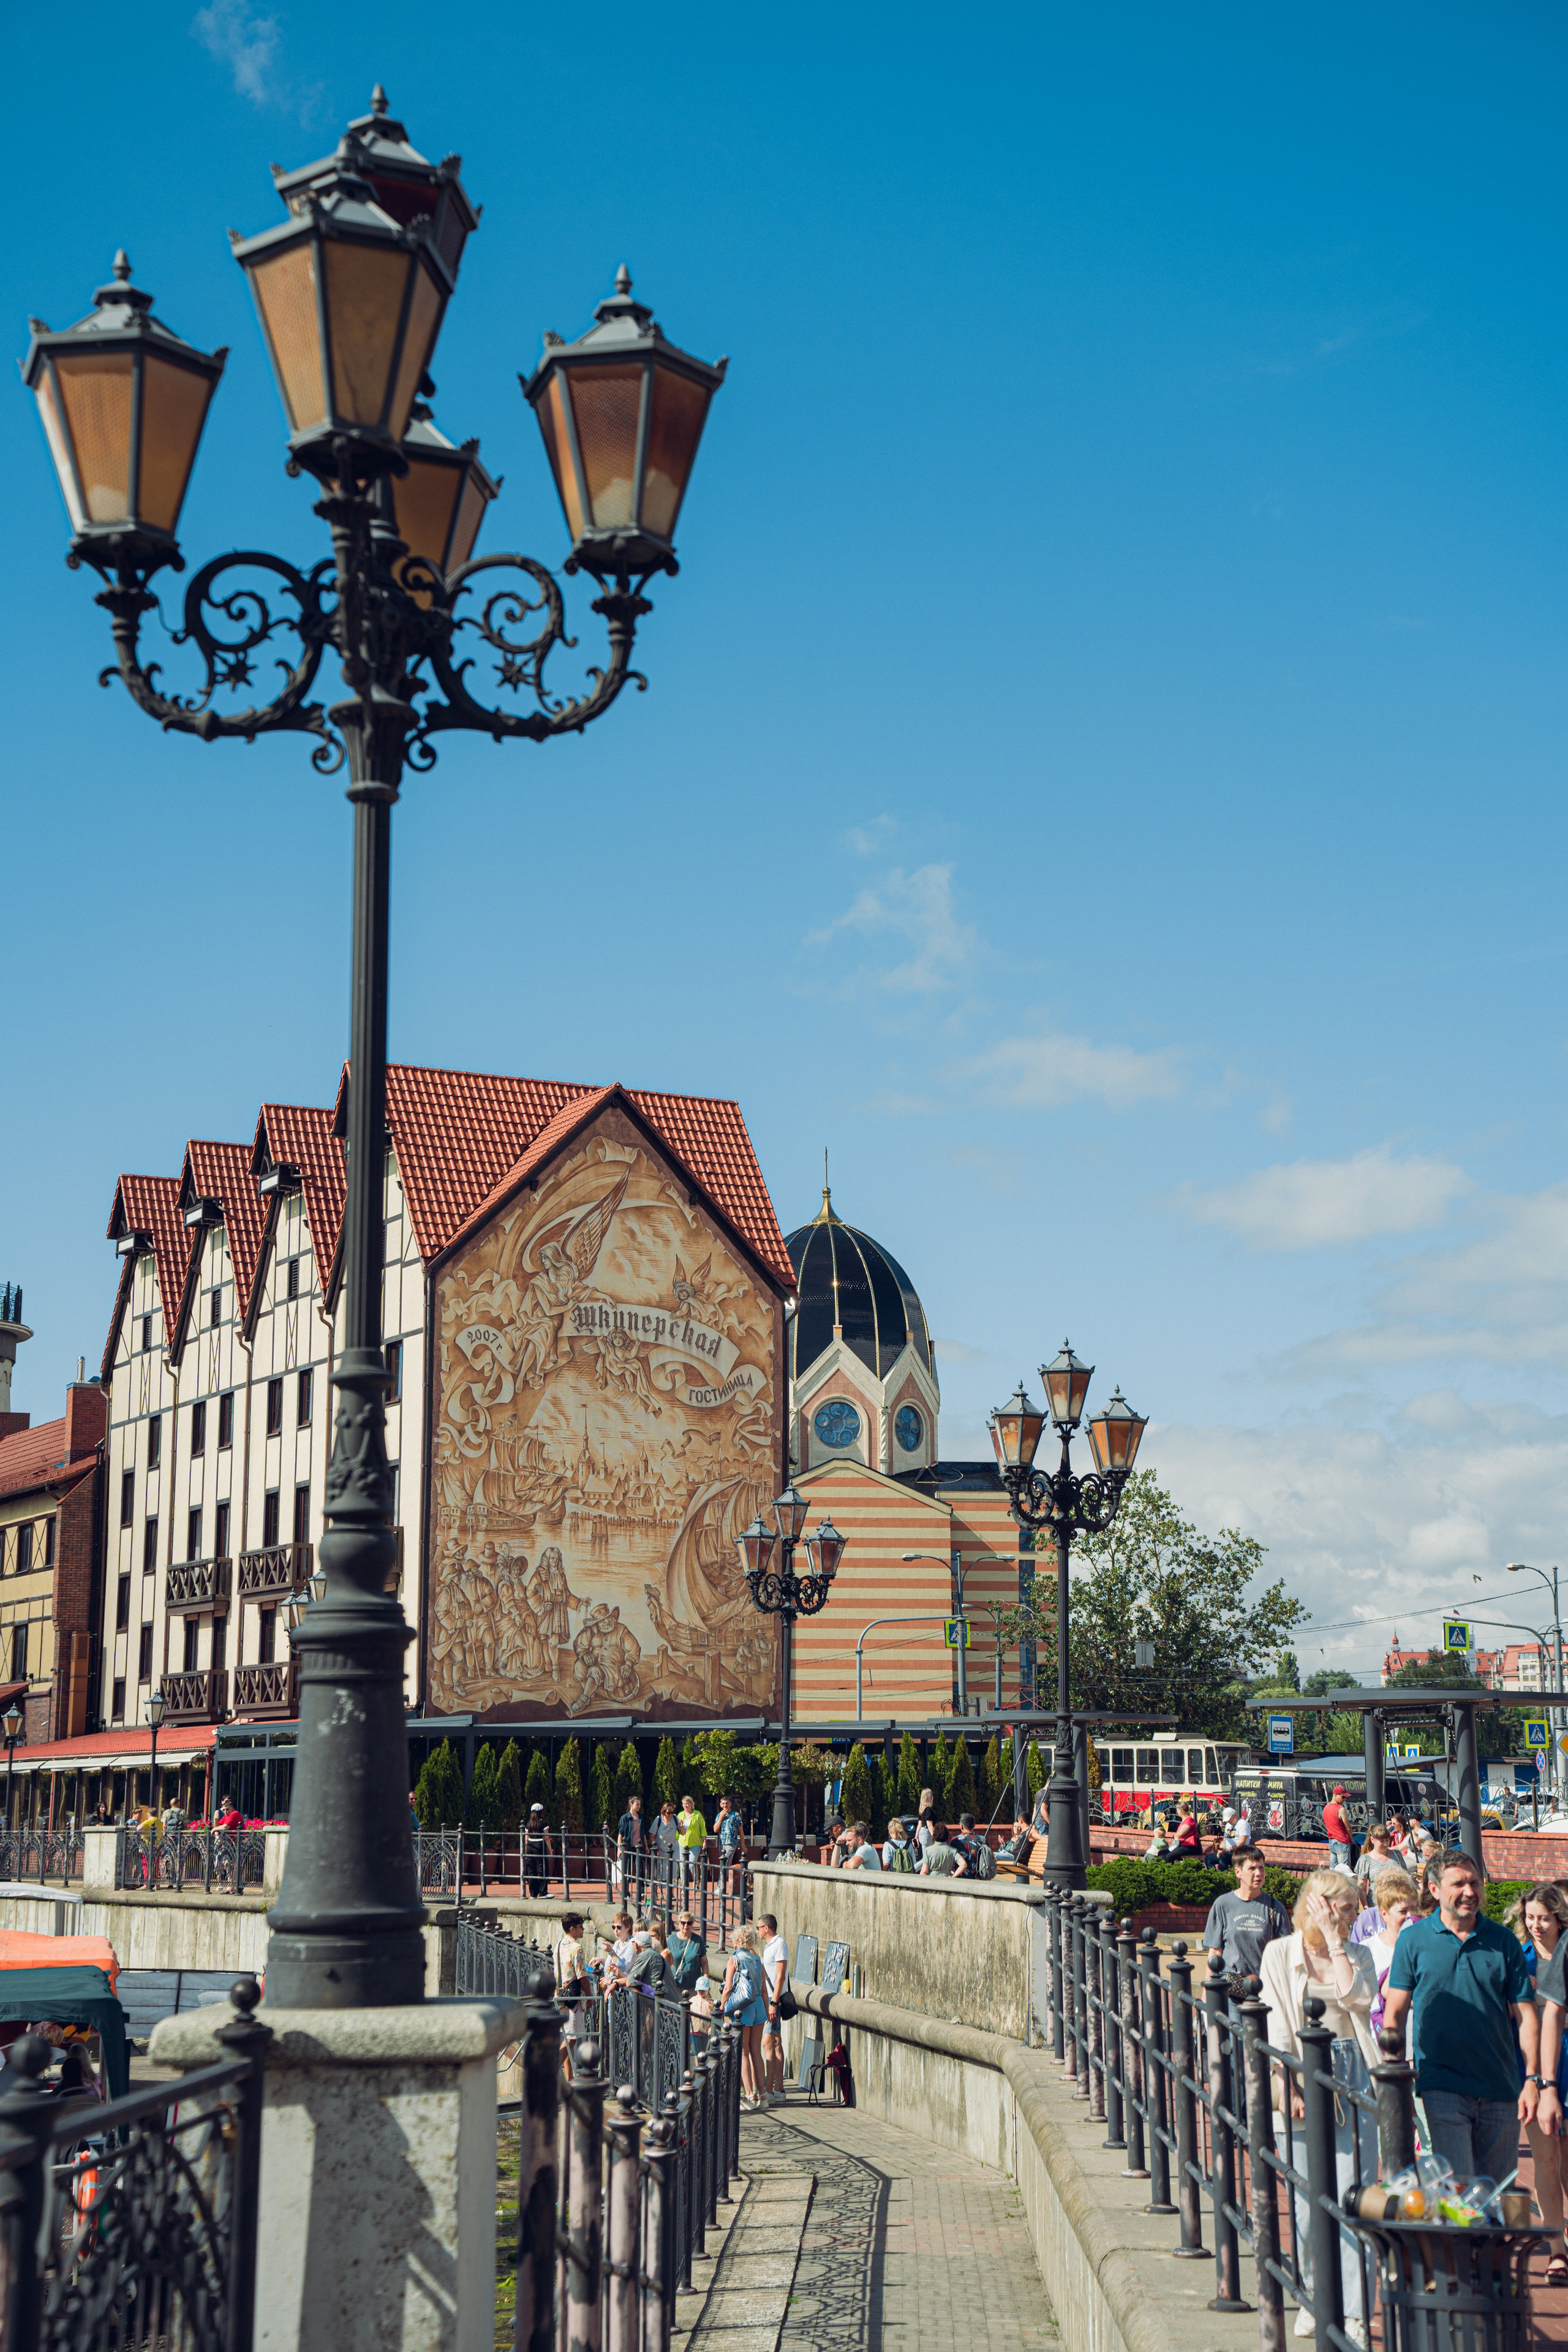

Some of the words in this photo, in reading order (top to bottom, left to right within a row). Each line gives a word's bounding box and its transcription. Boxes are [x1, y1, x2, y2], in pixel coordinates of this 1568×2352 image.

[467, 1329, 499, 1344] 2007
[570, 1304, 722, 1358] Шкиперская
[689, 1373, 753, 1403] ГОСТИНИЦА
[1235, 1780, 1261, 1789] НАПИТКИ
